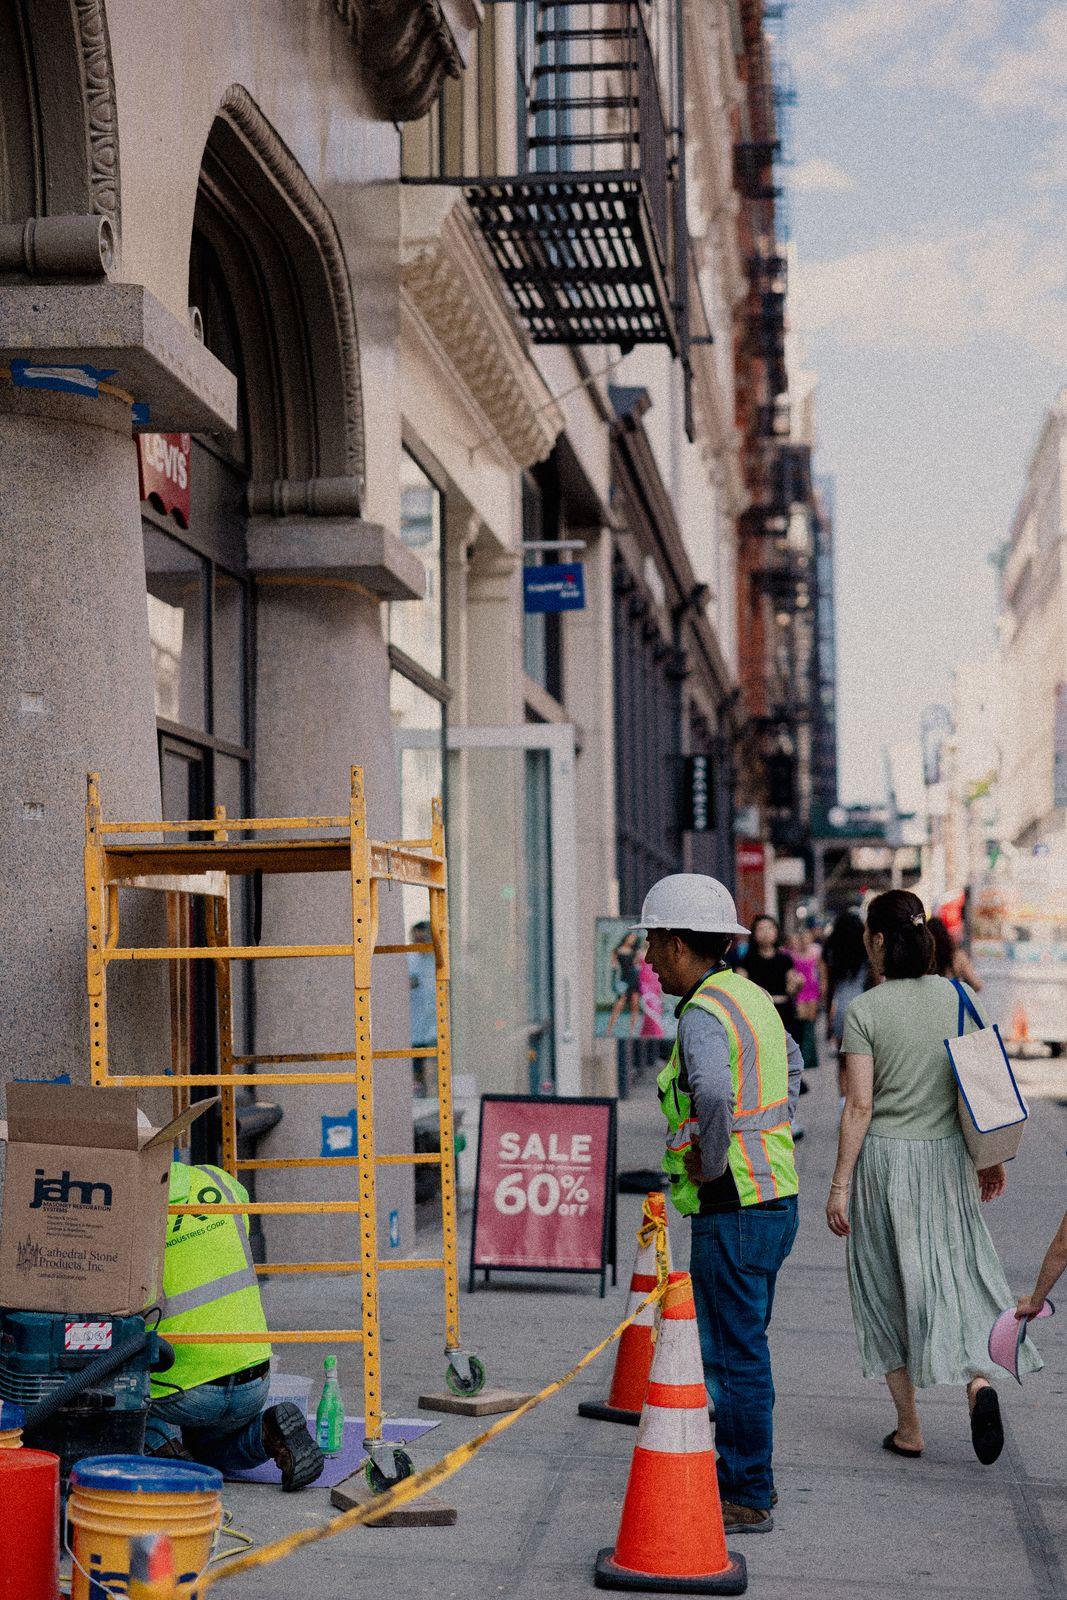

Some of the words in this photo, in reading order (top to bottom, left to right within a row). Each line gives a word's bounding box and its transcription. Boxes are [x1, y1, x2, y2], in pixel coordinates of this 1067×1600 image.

[499, 1132, 592, 1163] SALE
[494, 1172, 589, 1216] 60%
[43, 1201, 71, 1209] MASONRY
[72, 1203, 111, 1212] RESTORATION
[558, 1203, 588, 1217] OFF
[39, 1246, 86, 1260] Cathedral
[89, 1250, 118, 1263] Stone
[39, 1256, 84, 1271] Products,
[87, 1260, 104, 1272] Inc.
